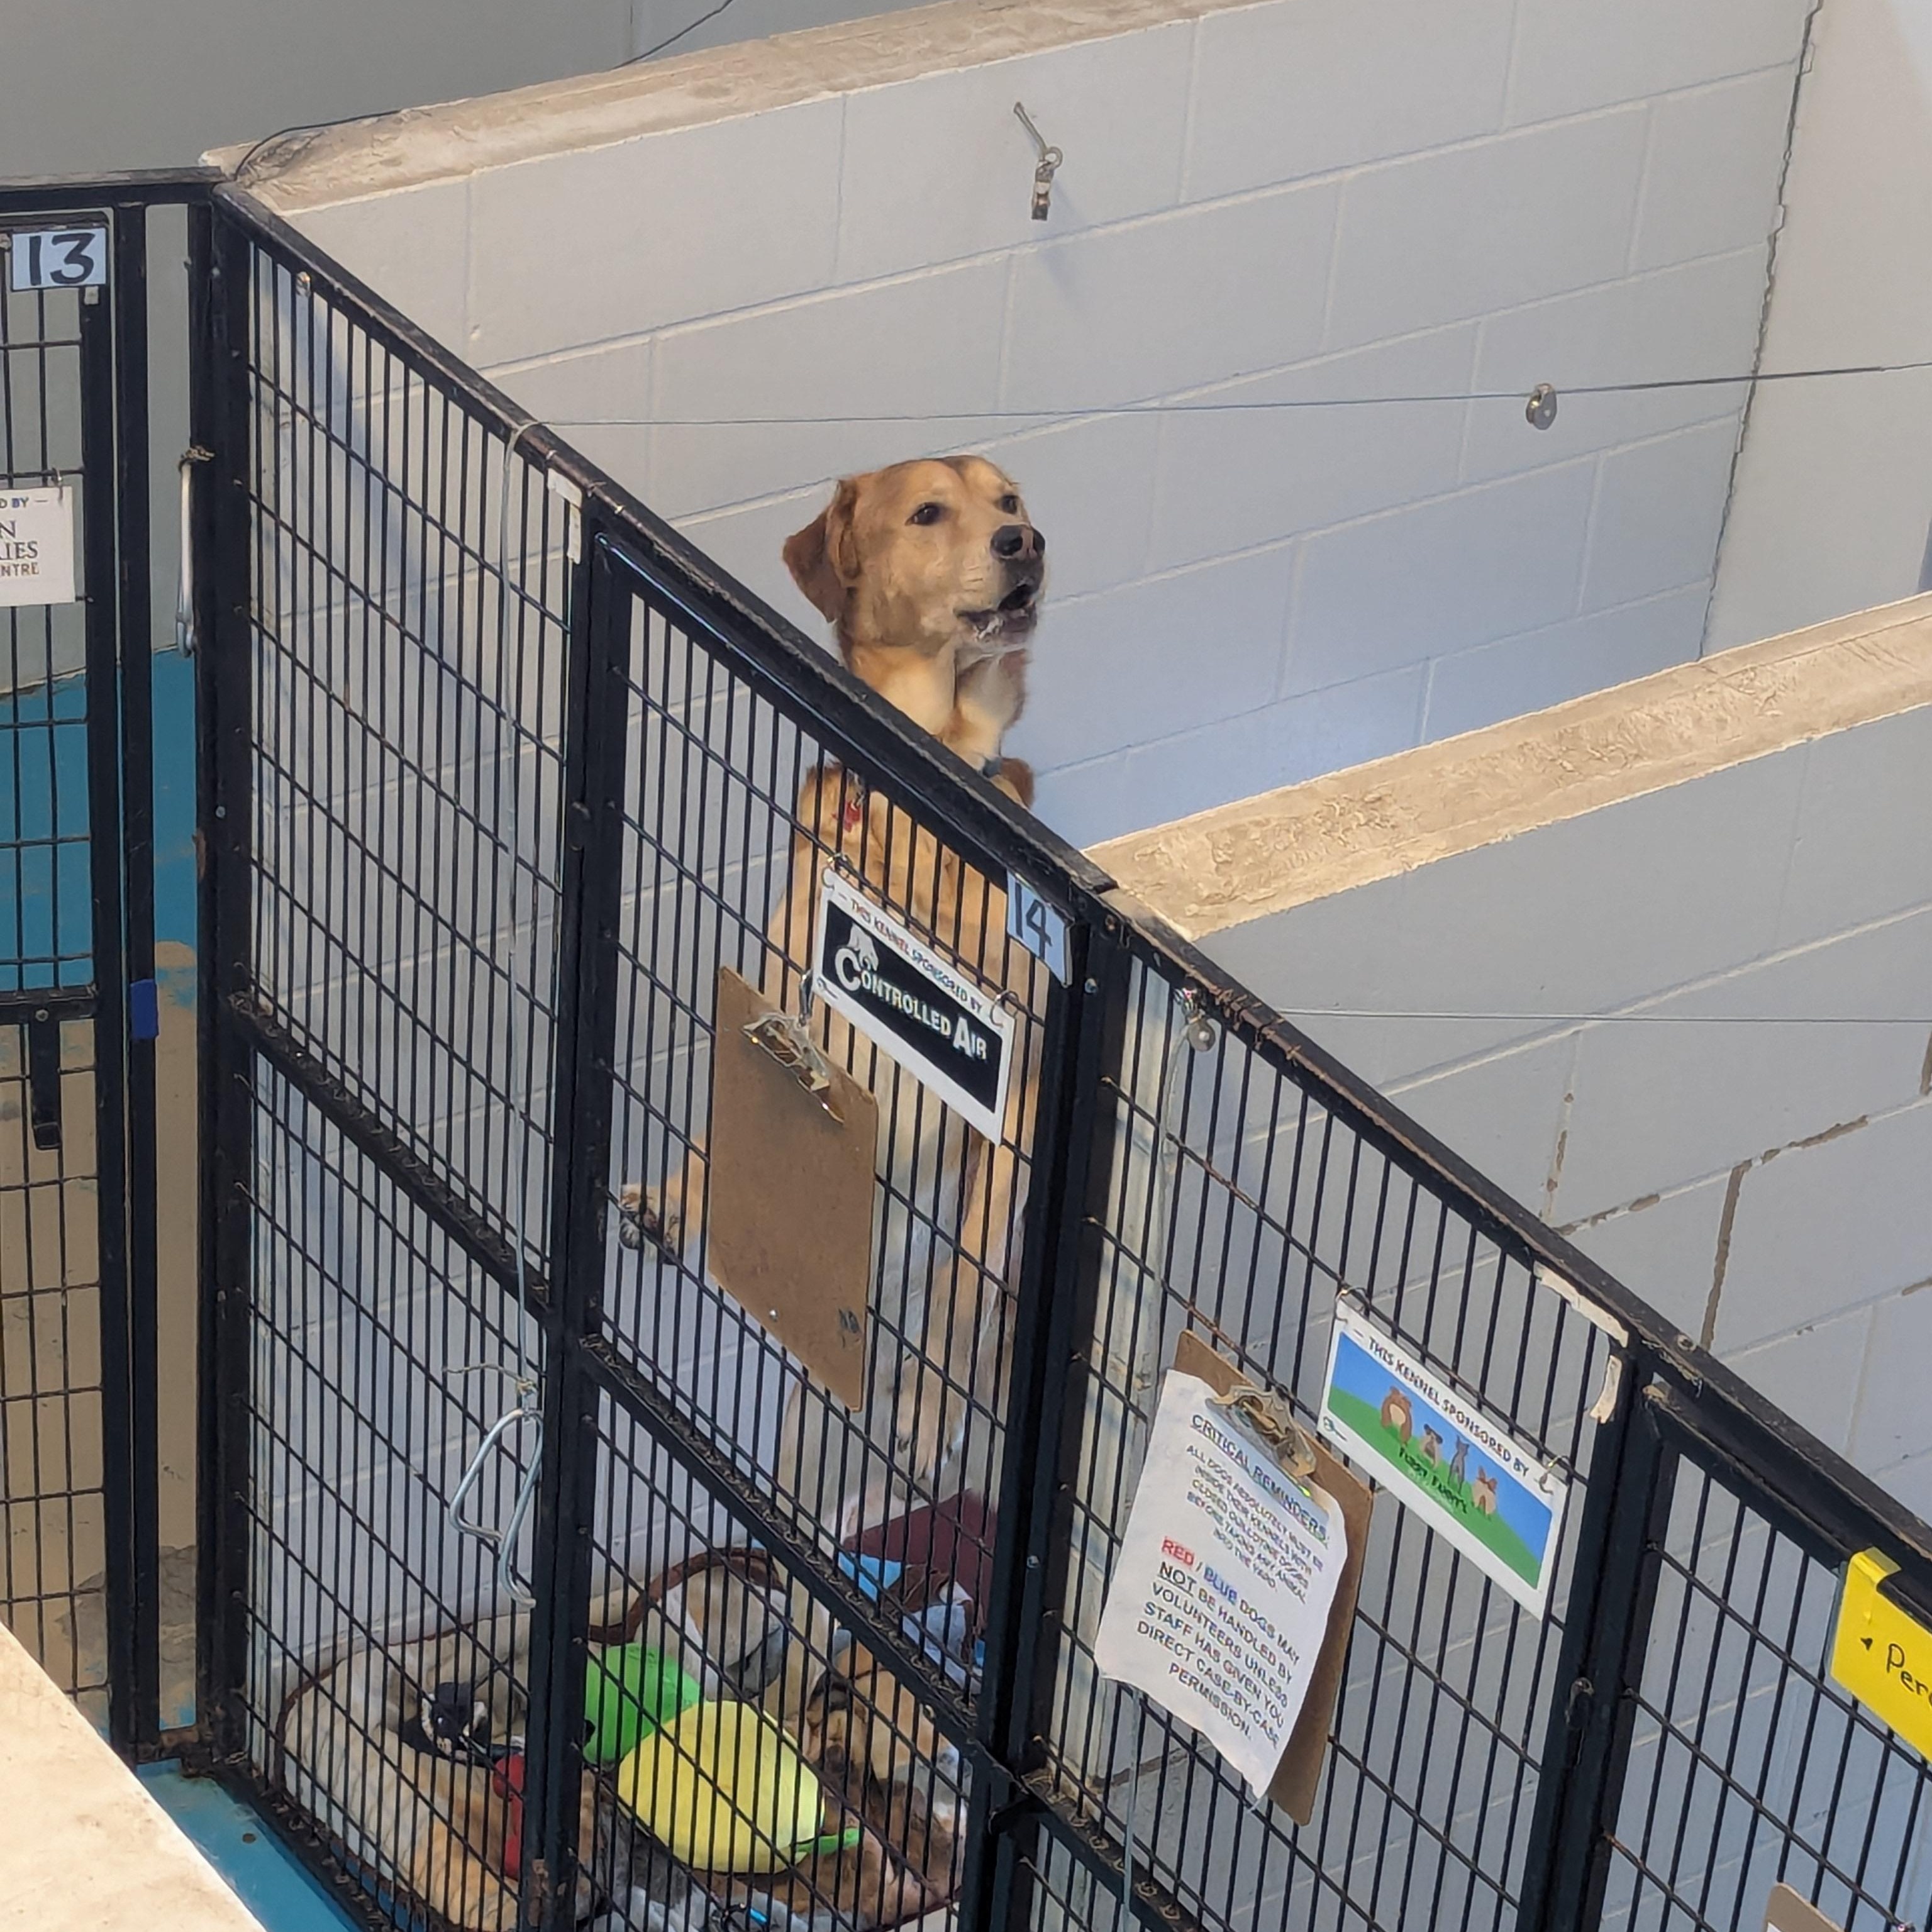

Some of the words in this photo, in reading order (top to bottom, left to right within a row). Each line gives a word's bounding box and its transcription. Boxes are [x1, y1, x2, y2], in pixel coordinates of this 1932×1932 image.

[29, 233, 96, 286] 13
[12, 497, 29, 509] BY
[1015, 882, 1053, 960] 14
[835, 948, 952, 1036] CONTROLLED
[953, 1016, 987, 1060] AIR
[1192, 1414, 1250, 1470] CRITICAL
[1368, 1336, 1394, 1366] THIS
[1396, 1359, 1440, 1406] KENNEL
[1441, 1399, 1512, 1462] SPONSORED
[1513, 1457, 1530, 1477] BY
[1152, 1581, 1242, 1659] VOLUNTEERS
[1245, 1653, 1288, 1709] UNLESS
[1160, 1562, 1197, 1596] NOT
[1198, 1588, 1216, 1612] BE
[1218, 1605, 1277, 1666] HANDLED
[1277, 1662, 1292, 1685] BY
[1162, 1538, 1195, 1567] RED
[1204, 1567, 1238, 1606] BLUE
[1240, 1599, 1276, 1639] DOGS
[1277, 1633, 1301, 1666] MAY
[1137, 1620, 1196, 1663] DIRECT
[1196, 1657, 1280, 1751] CASE-BY-CASE
[1144, 1601, 1194, 1636] STAFF
[1195, 1631, 1221, 1663] HAS
[1223, 1659, 1262, 1701] GIVEN
[1265, 1694, 1284, 1729] YOU
[1169, 1662, 1252, 1741] PERMISSION.
[1887, 1643, 1932, 1707] Per
